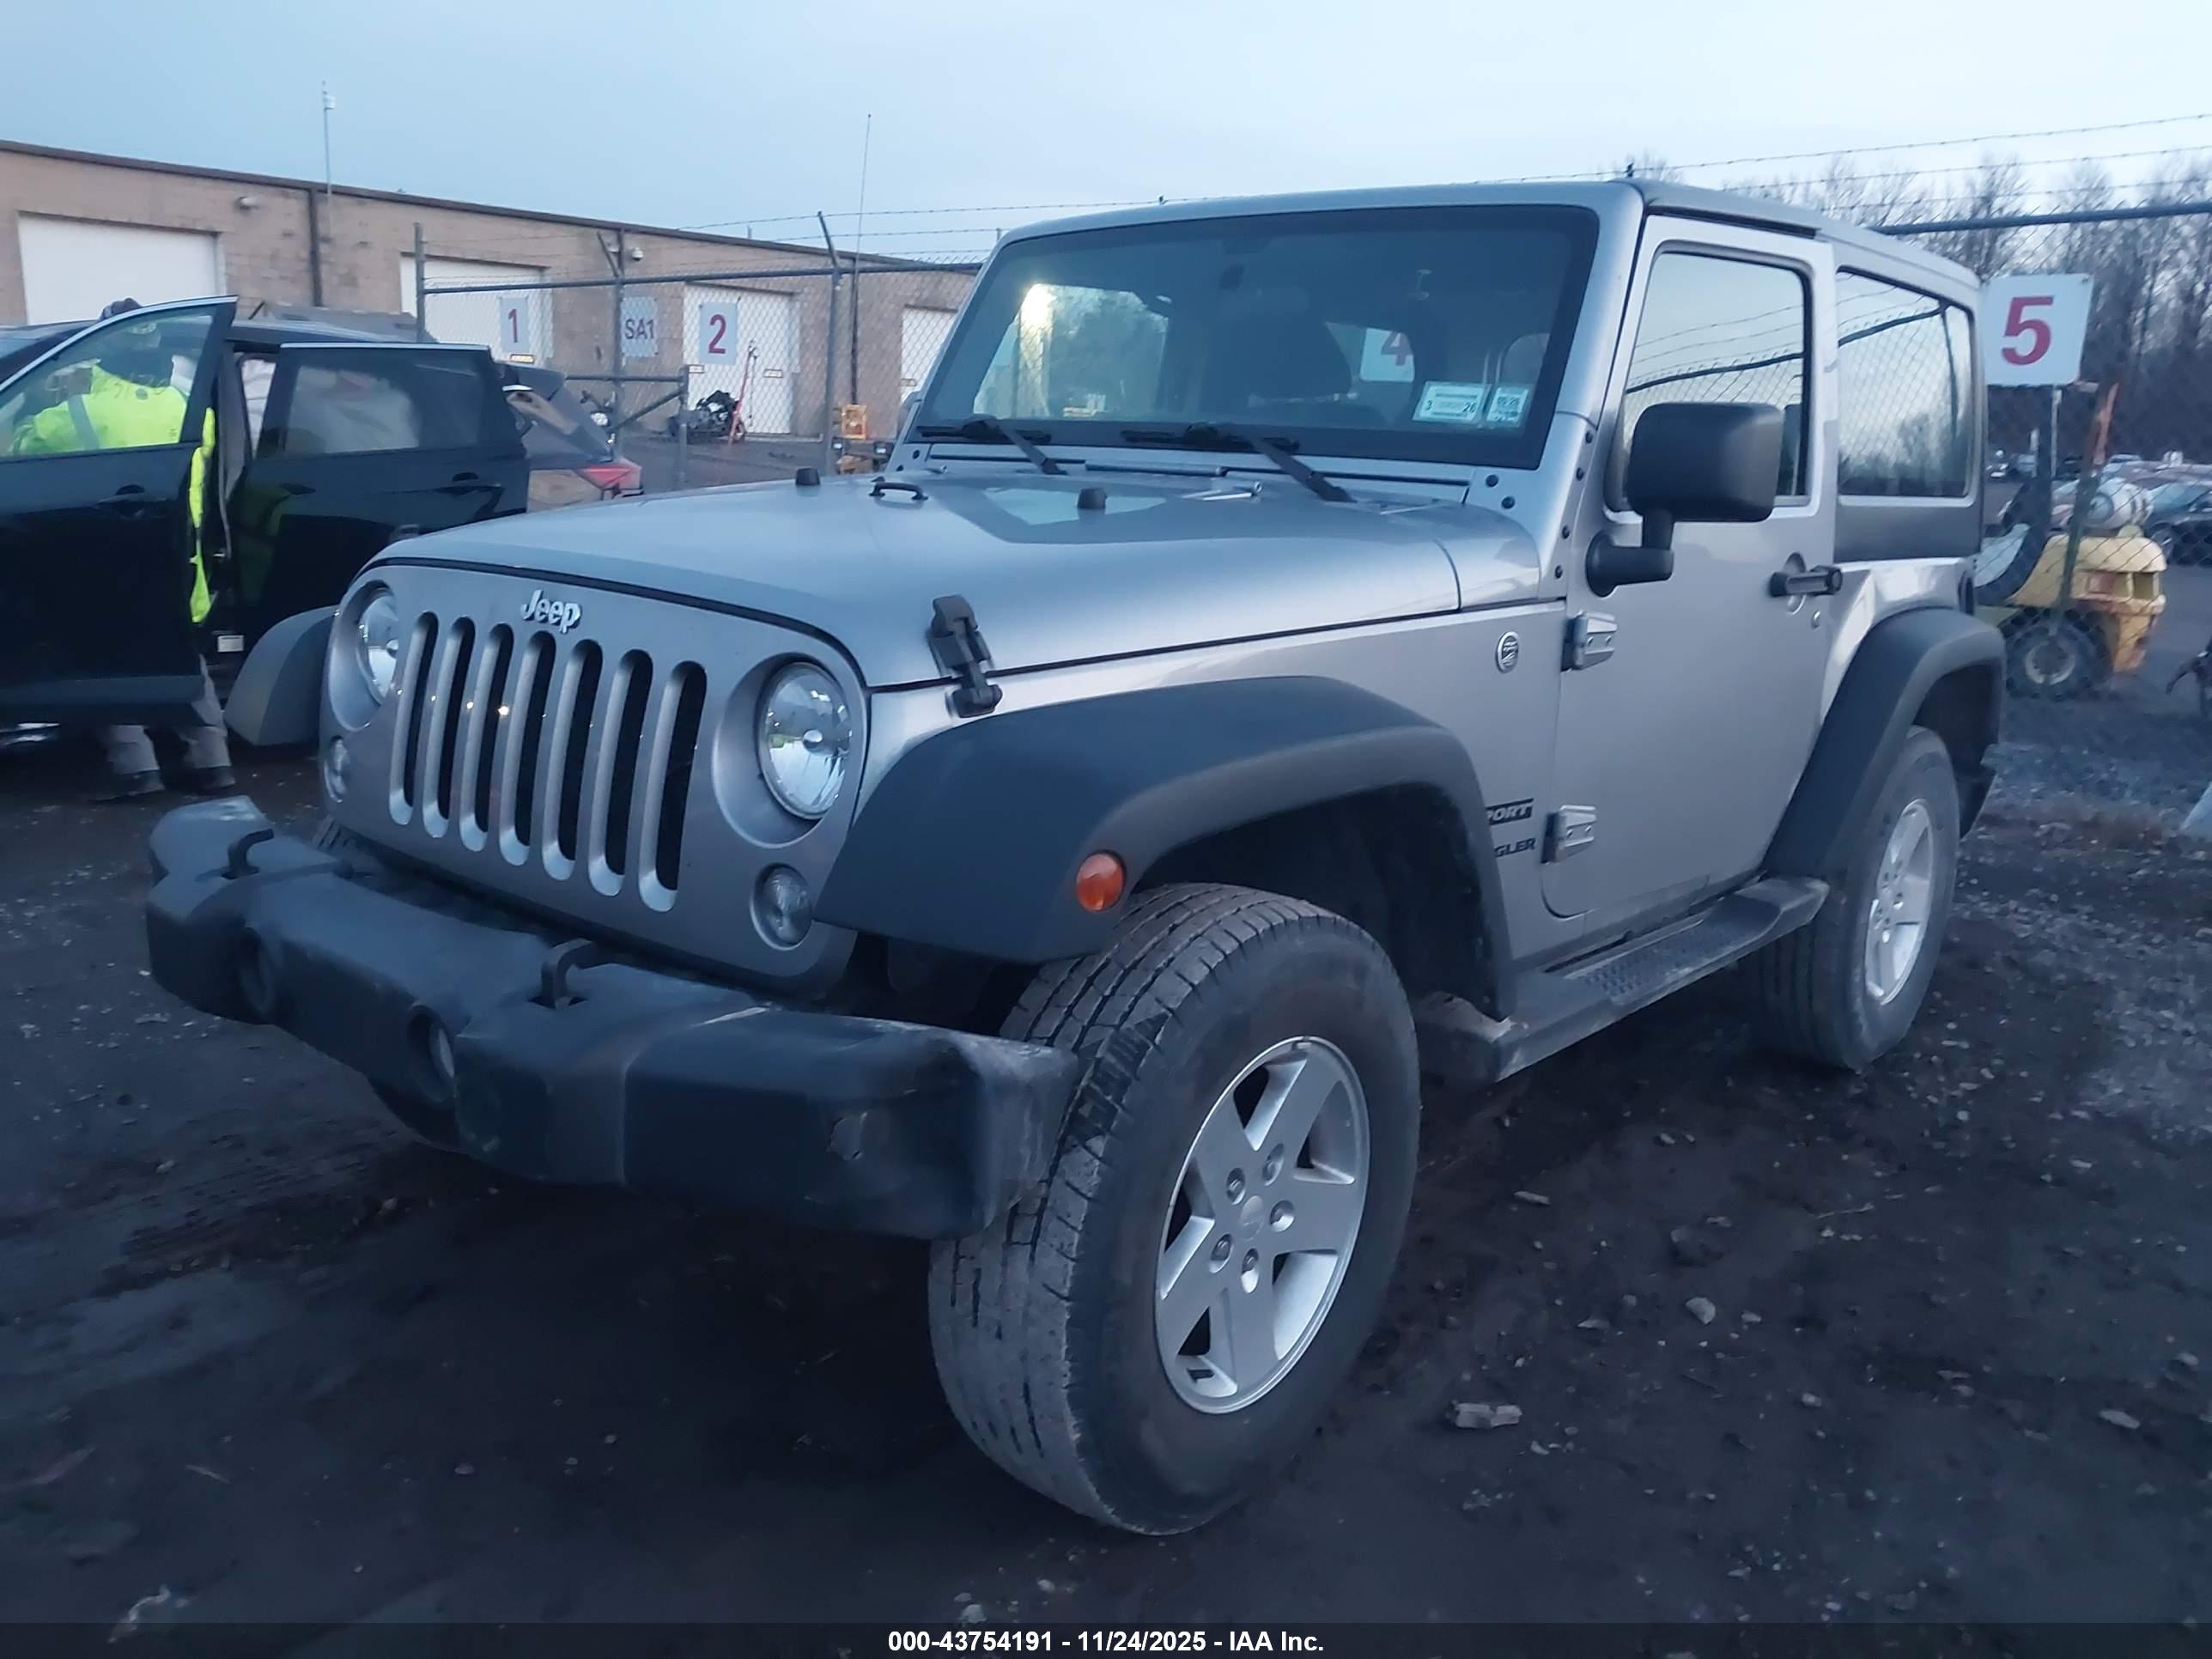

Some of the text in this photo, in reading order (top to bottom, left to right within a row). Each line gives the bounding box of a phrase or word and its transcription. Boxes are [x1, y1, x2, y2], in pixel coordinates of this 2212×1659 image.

[507, 308, 519, 343] 1
[624, 318, 655, 341] SA1
[708, 313, 726, 355] 2
[2001, 295, 2054, 366] 5
[1381, 331, 1413, 367] 4
[520, 589, 581, 634] Jeep
[1486, 802, 1533, 822] PORT
[1494, 837, 1536, 859] GLER
